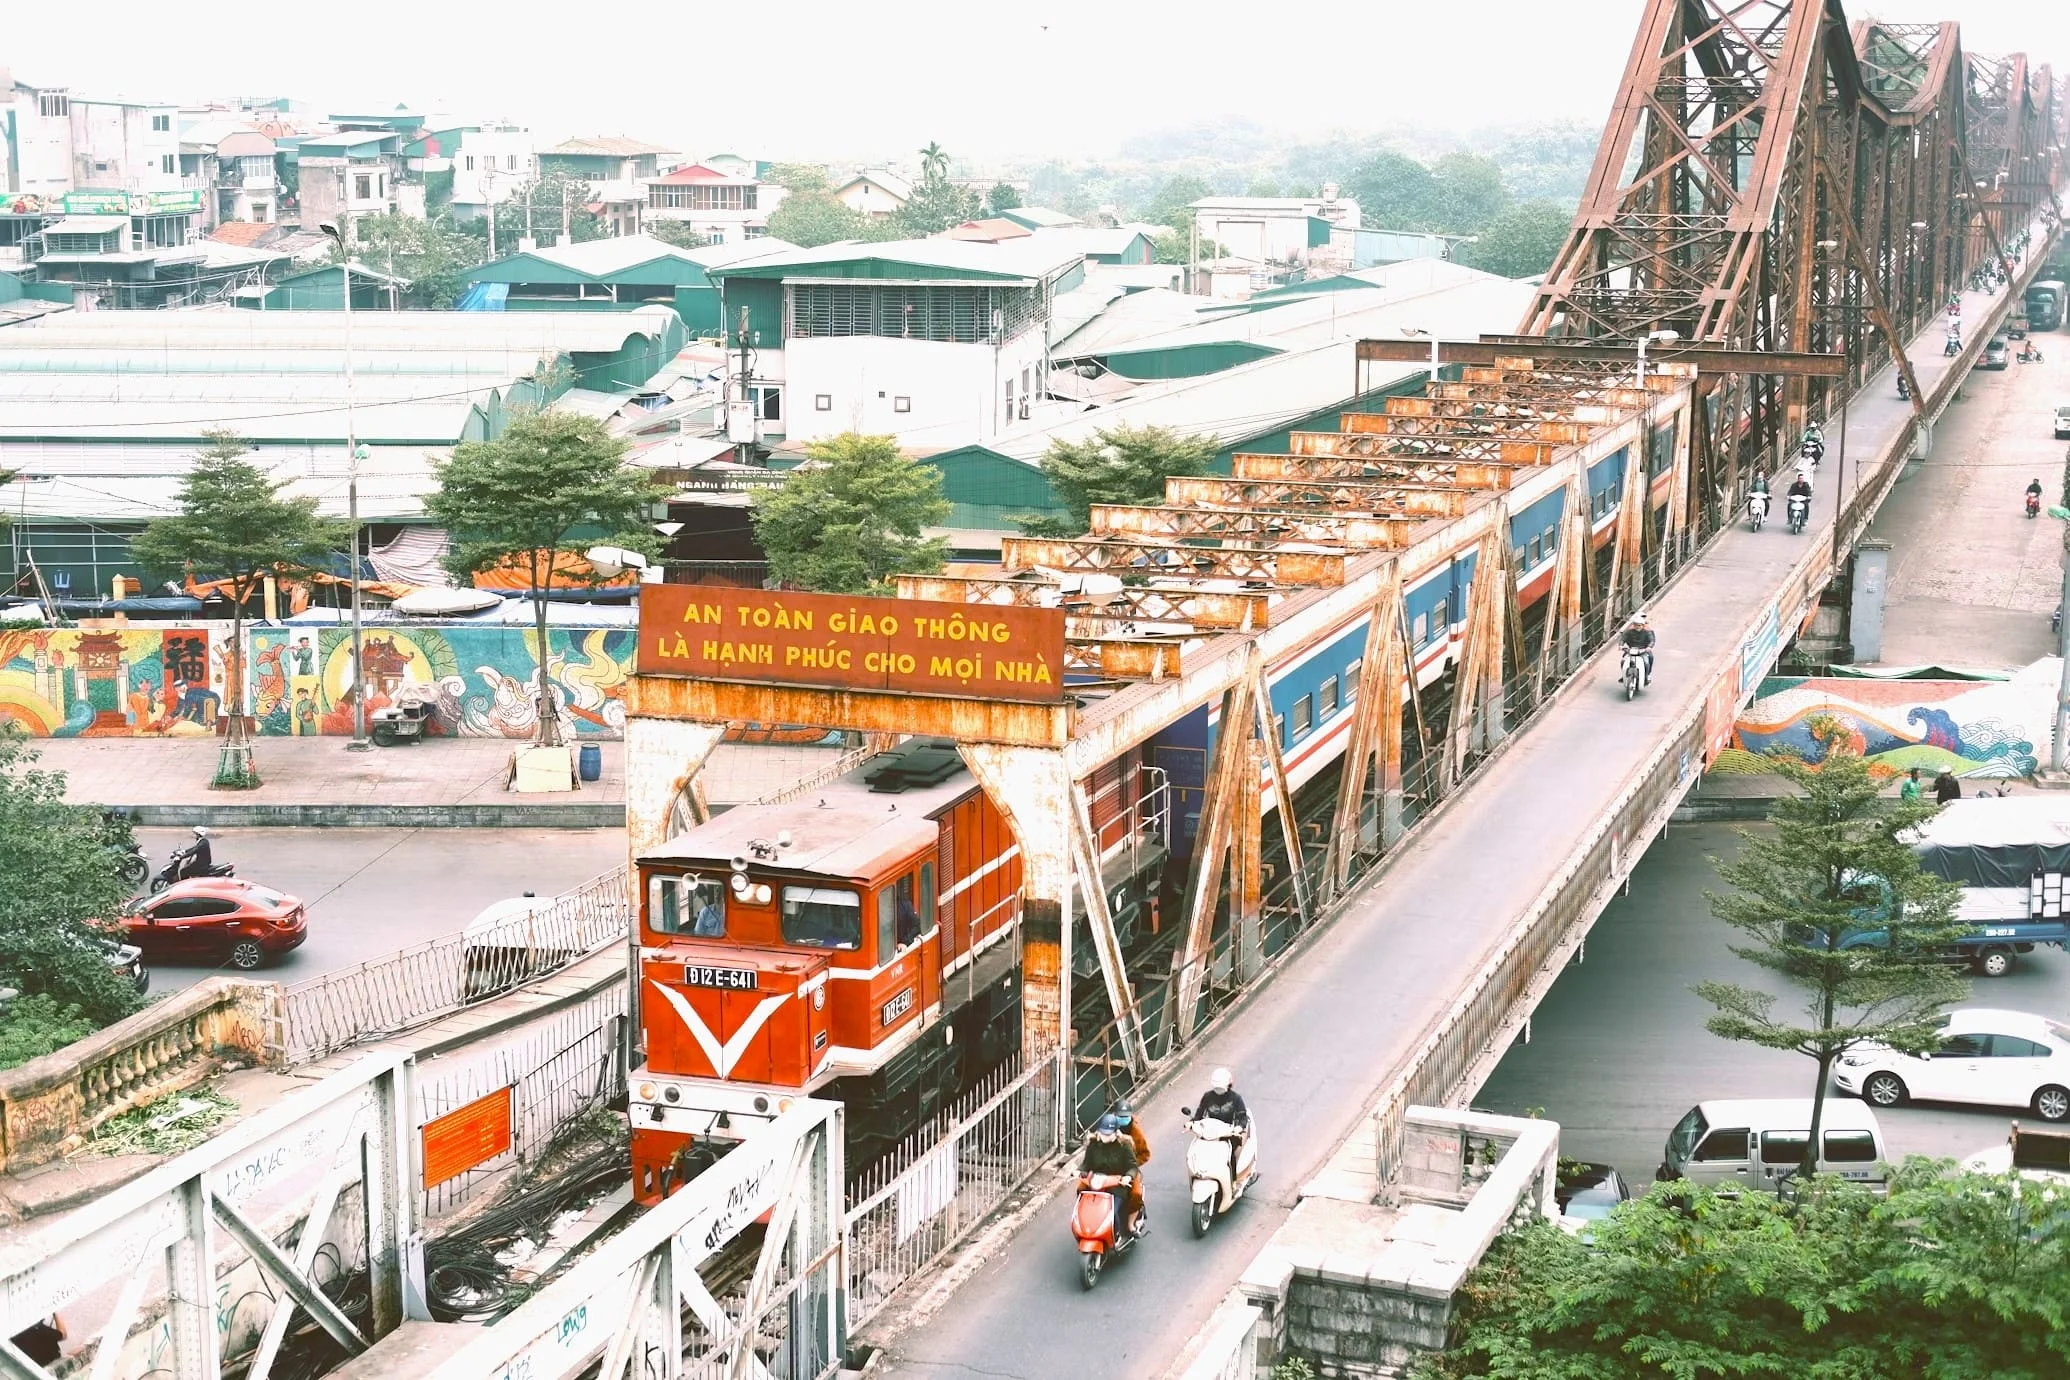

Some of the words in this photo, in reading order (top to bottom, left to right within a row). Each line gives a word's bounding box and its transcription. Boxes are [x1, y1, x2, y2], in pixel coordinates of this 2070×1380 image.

[683, 603, 722, 625] AN
[737, 601, 813, 631] TOÀN
[913, 612, 1011, 643] THÔNG
[657, 630, 690, 659] LÀ
[703, 640, 773, 668] HẠNH
[785, 639, 852, 670] PHÚC
[864, 652, 916, 674] CHO
[995, 652, 1052, 684] NHÀ
